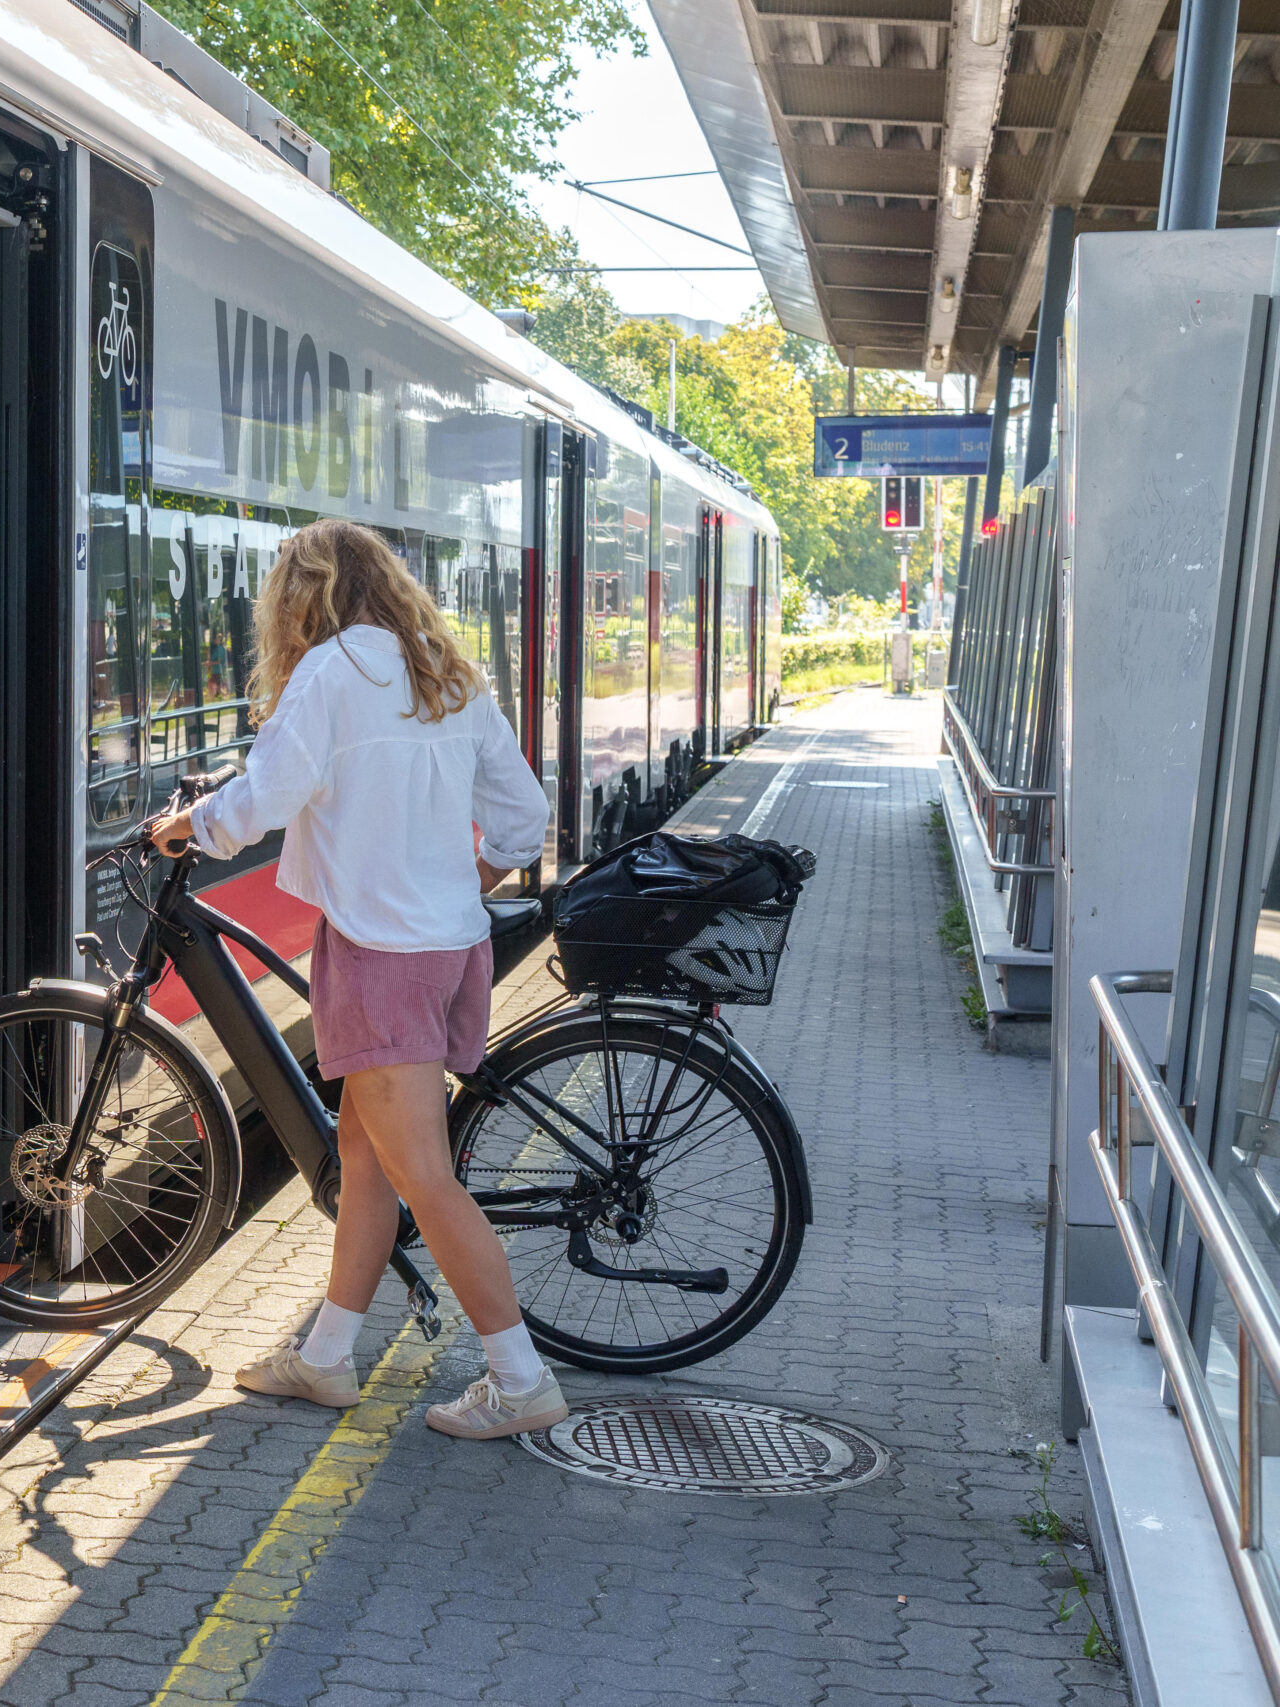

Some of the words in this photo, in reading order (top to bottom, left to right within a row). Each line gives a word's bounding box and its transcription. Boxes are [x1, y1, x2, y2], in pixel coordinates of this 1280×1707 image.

[214, 298, 409, 512] VMOBIL
[834, 437, 849, 460] 2
[861, 440, 910, 452] Bludenz
